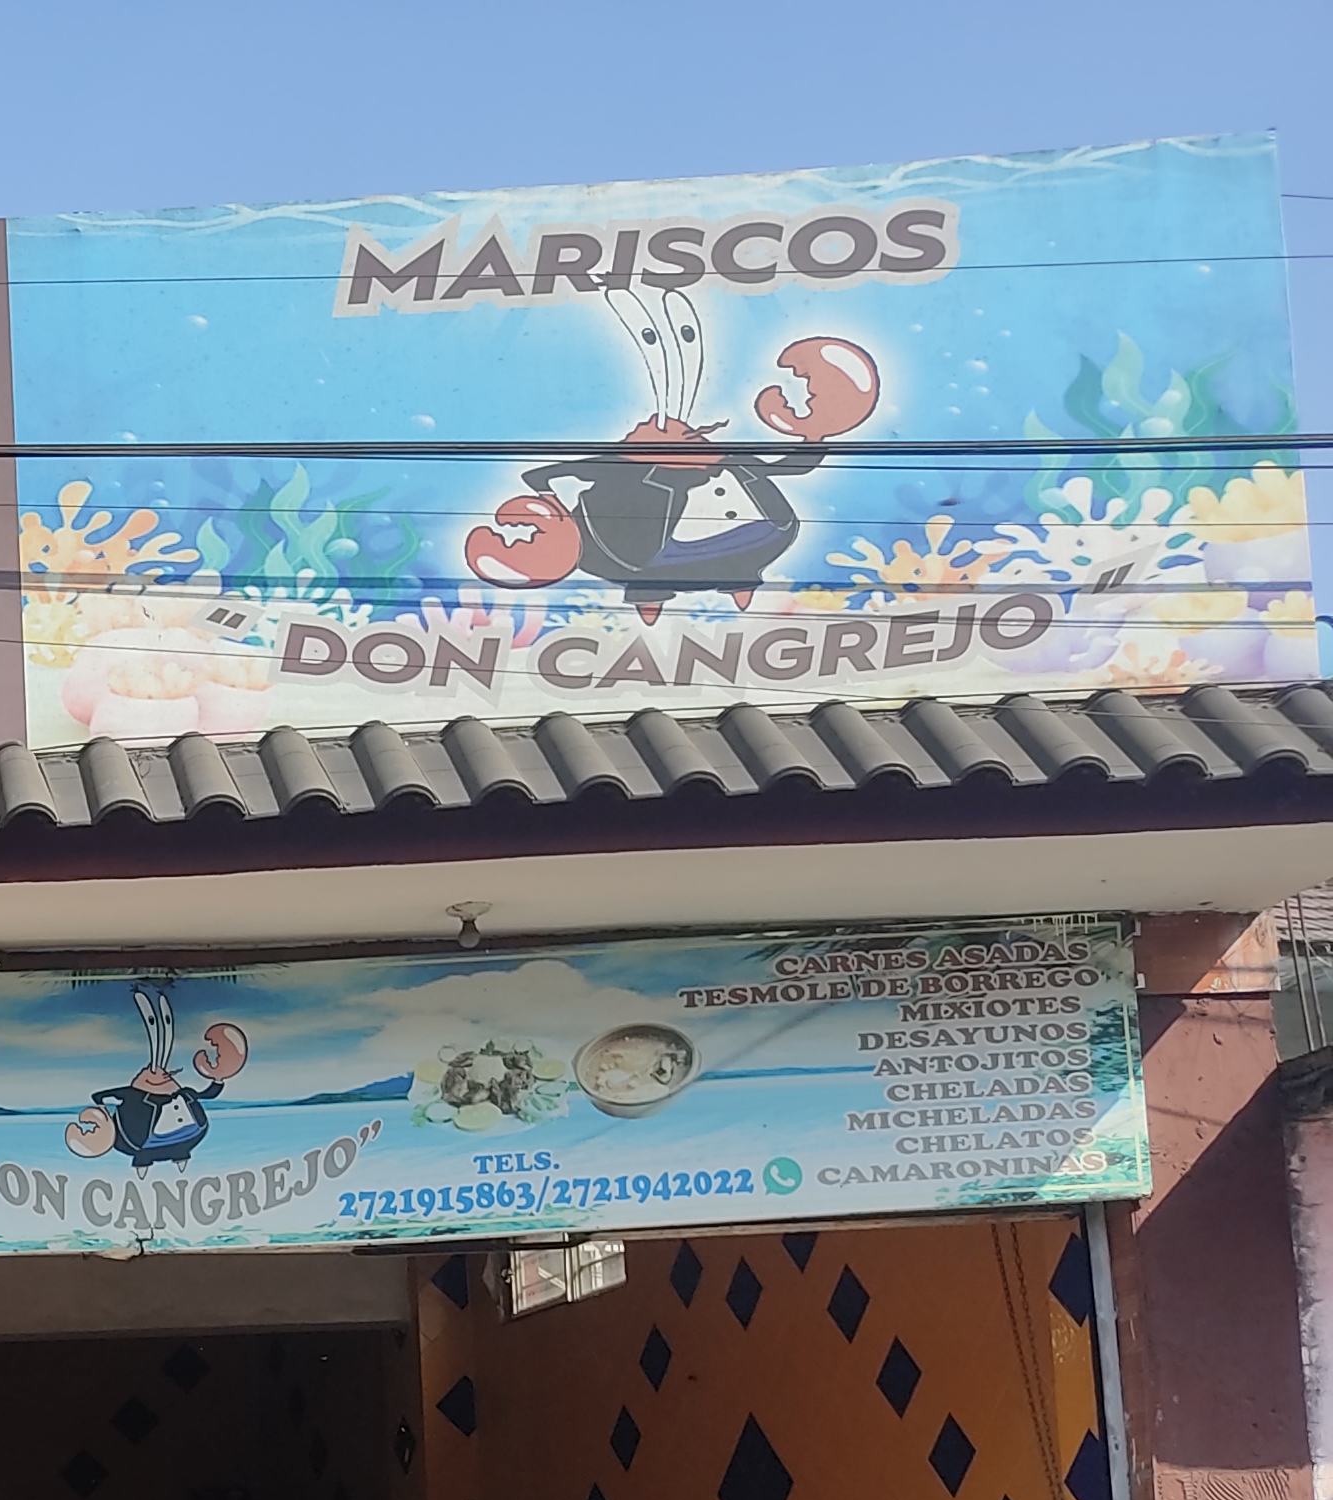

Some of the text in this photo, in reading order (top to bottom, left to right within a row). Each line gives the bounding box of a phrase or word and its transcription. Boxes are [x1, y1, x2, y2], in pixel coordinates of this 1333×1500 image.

[347, 208, 947, 305] MARISCOS
[775, 943, 1090, 976] CARNES ASADAS
[679, 969, 1100, 1008] TESMOLE DE BORREGO
[899, 997, 1082, 1023] MIXIOTES
[858, 1022, 1088, 1051] DESAYUNOS
[873, 1050, 1089, 1077] ANTOJITOS
[887, 1075, 1091, 1102] CHELADAS
[846, 1101, 1096, 1131] MICHELADAS
[895, 1128, 1095, 1155] CHELATOS
[472, 1150, 560, 1175] TELS.
[816, 1152, 1106, 1186] CAMARONINAS
